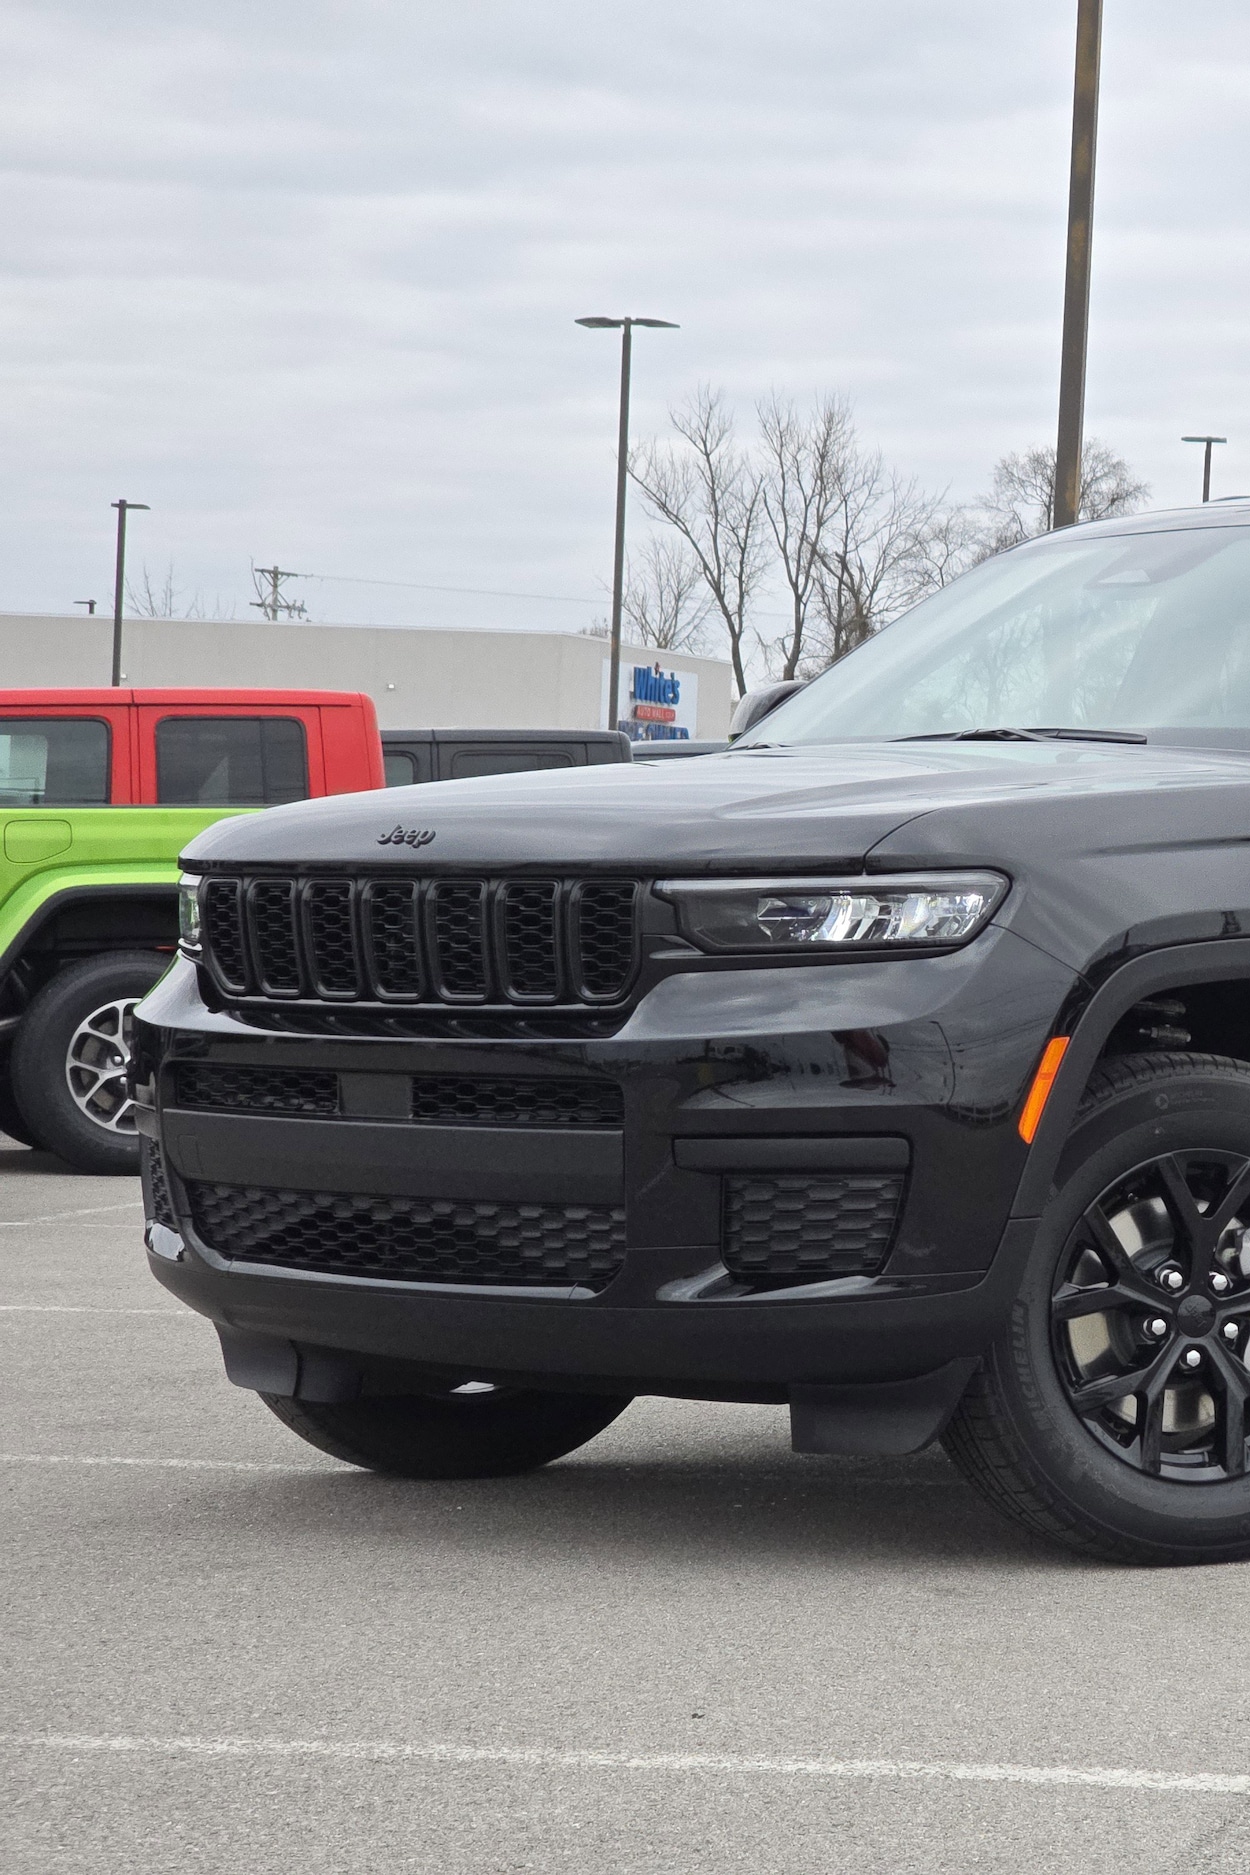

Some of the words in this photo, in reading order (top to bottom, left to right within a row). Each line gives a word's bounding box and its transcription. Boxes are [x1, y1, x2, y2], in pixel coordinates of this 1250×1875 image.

[634, 666, 680, 704] White's
[376, 824, 436, 849] Jeep
[1012, 1301, 1055, 1431] MICHELIN
